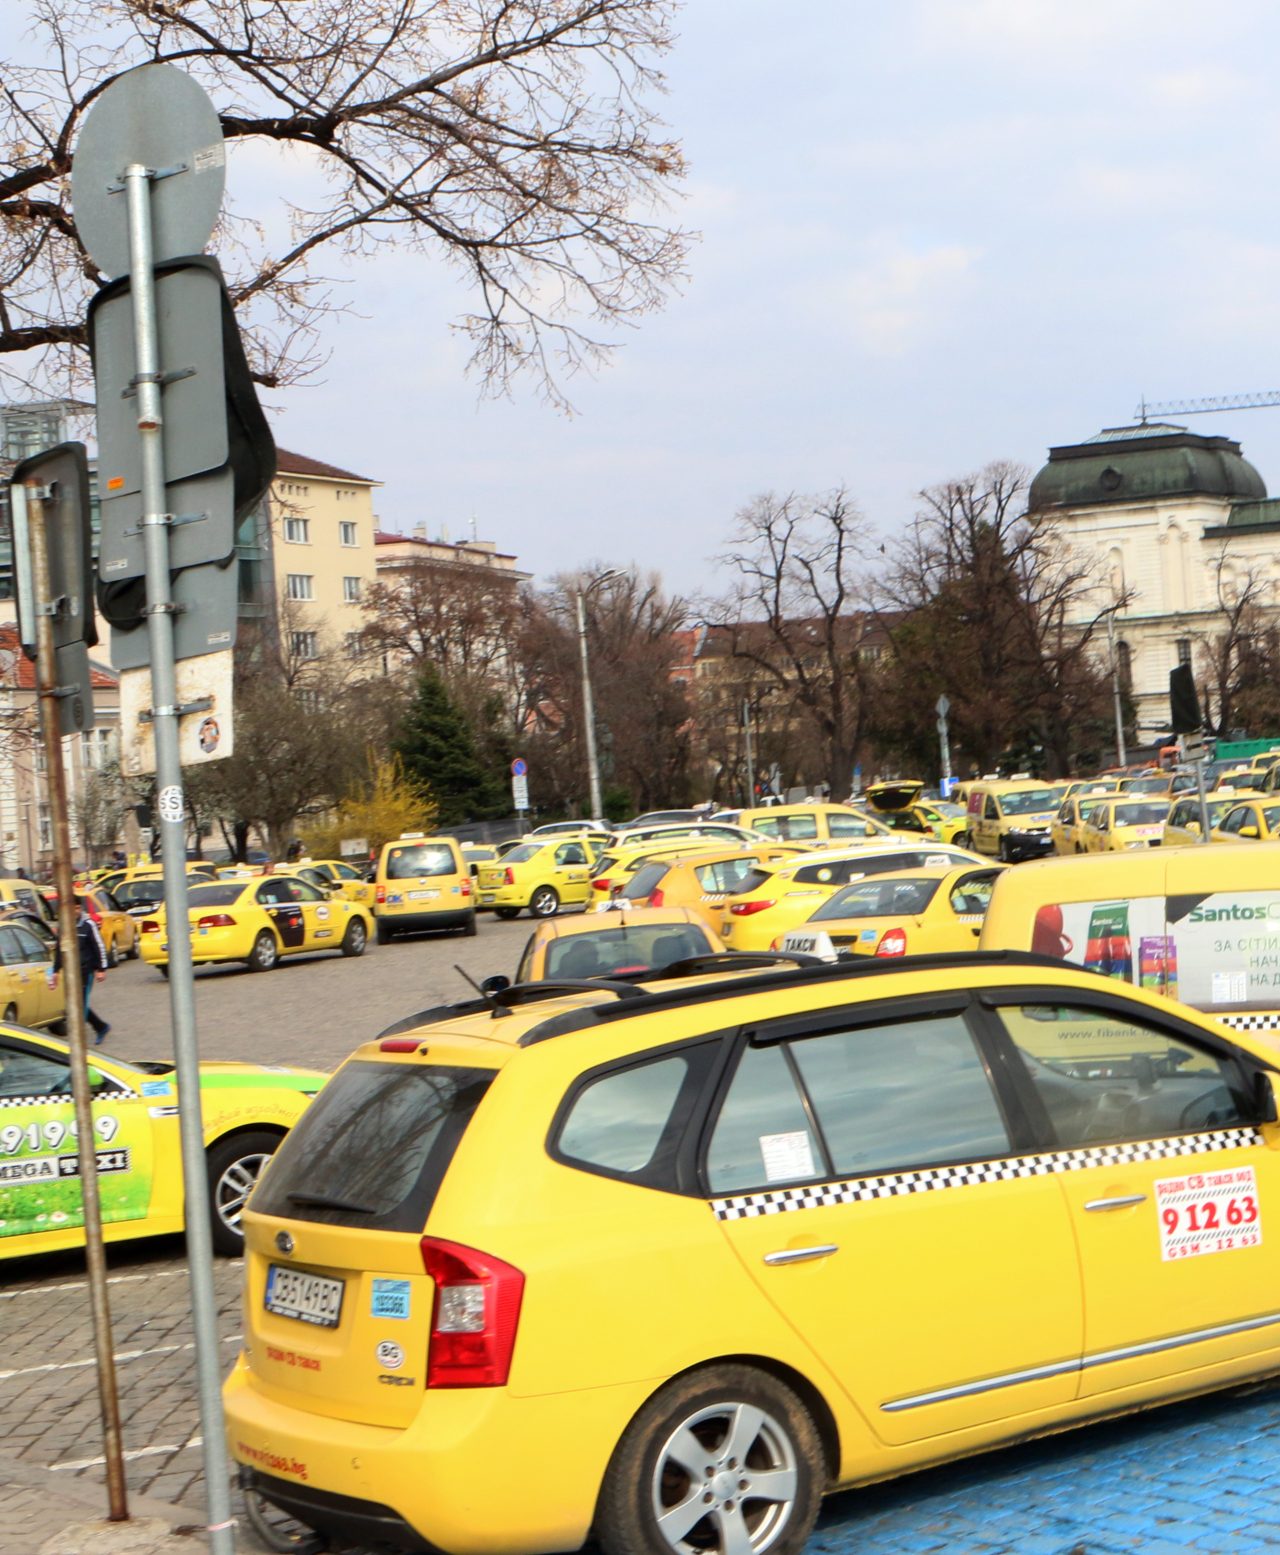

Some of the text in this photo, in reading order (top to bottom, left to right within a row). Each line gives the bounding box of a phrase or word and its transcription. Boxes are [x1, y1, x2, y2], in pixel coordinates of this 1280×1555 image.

[1214, 939, 1233, 953] ЗА
[1250, 972, 1270, 986] НА
[60, 1153, 126, 1174] TXI
[1162, 1196, 1257, 1235] 9 12 63
[380, 1344, 399, 1359] BG
